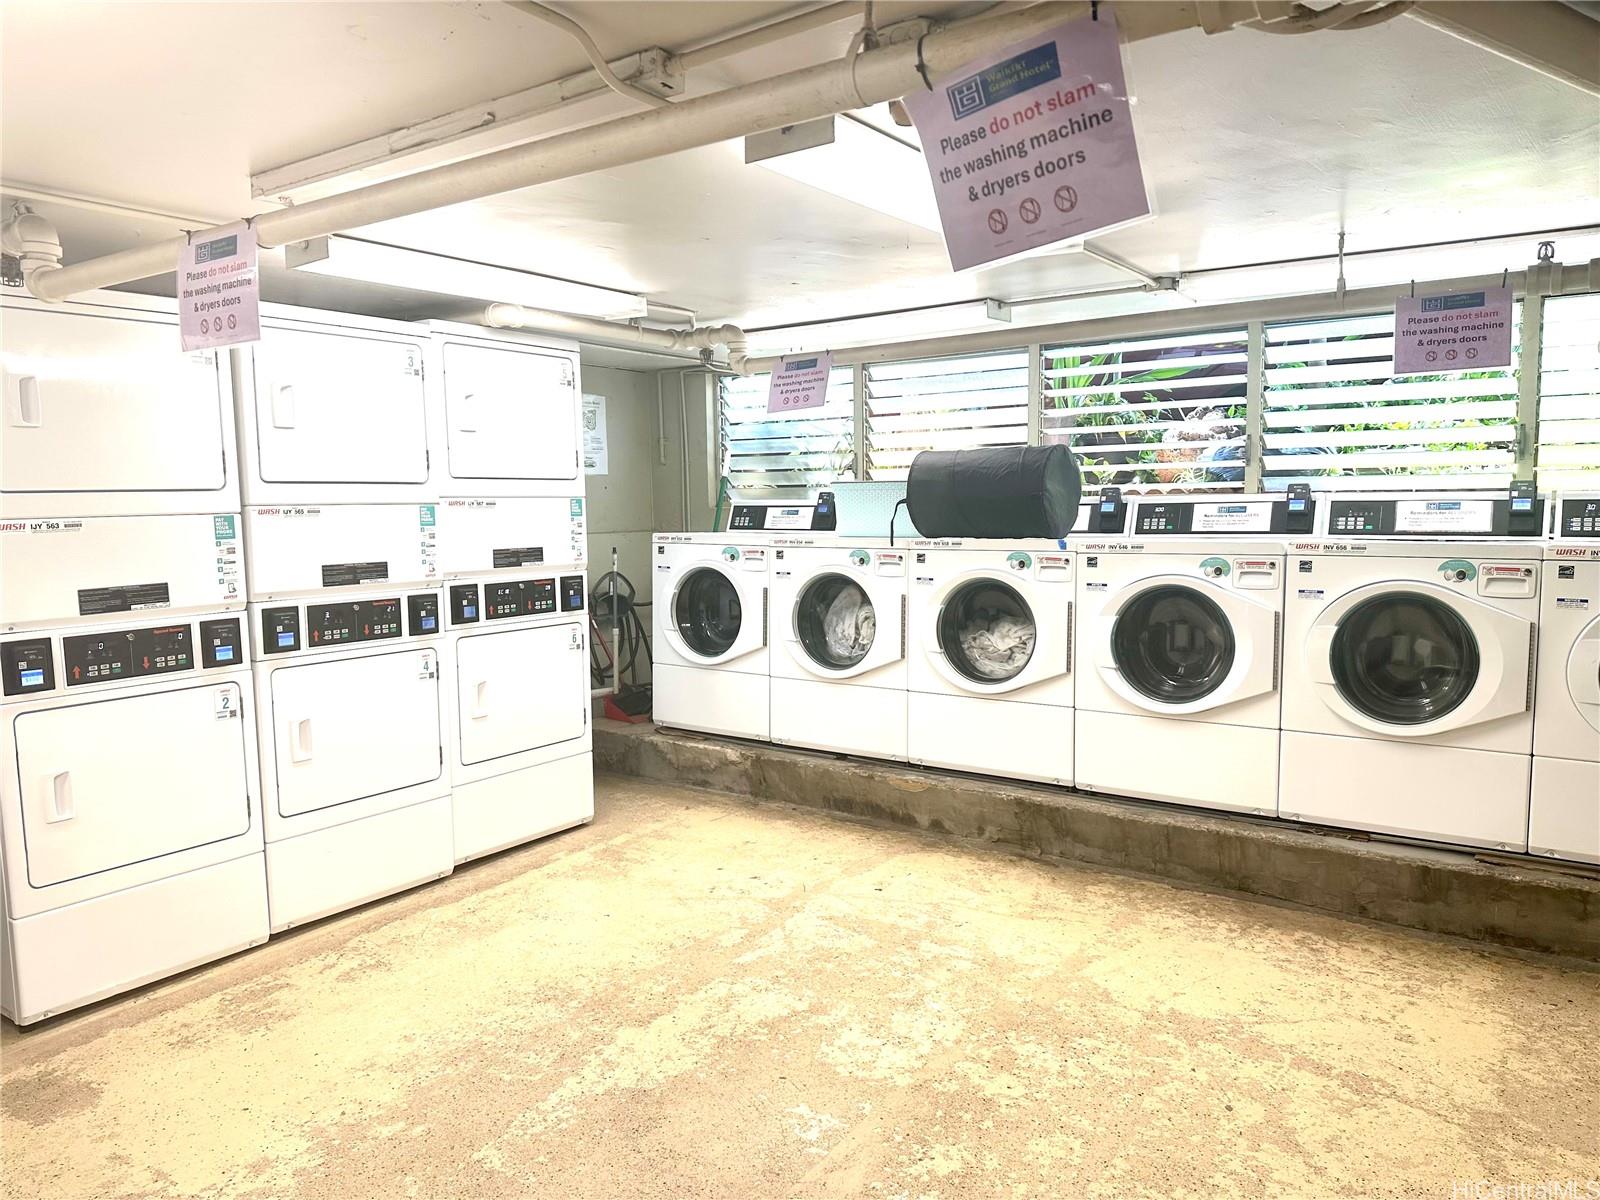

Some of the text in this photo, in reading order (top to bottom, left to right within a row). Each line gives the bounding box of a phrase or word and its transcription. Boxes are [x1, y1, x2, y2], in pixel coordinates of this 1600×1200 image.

[940, 82, 1097, 155] Please do not slam
[939, 108, 1114, 184] the washing machine
[968, 149, 1086, 202] & dryers doors
[186, 261, 248, 282] Please do not slam
[183, 276, 252, 299] the washing machine
[194, 295, 241, 312] & dryers doors
[1407, 310, 1499, 325] Please do not slam
[1402, 321, 1504, 337] the washing machine
[1426, 336, 1457, 347] dryers
[1459, 334, 1488, 343] doors
[408, 356, 414, 367] 3
[46, 522, 60, 530] 563
[1295, 542, 1320, 550] WASH
[1556, 548, 1586, 556] WASH
[423, 660, 429, 672] 4
[222, 696, 230, 710] 2
